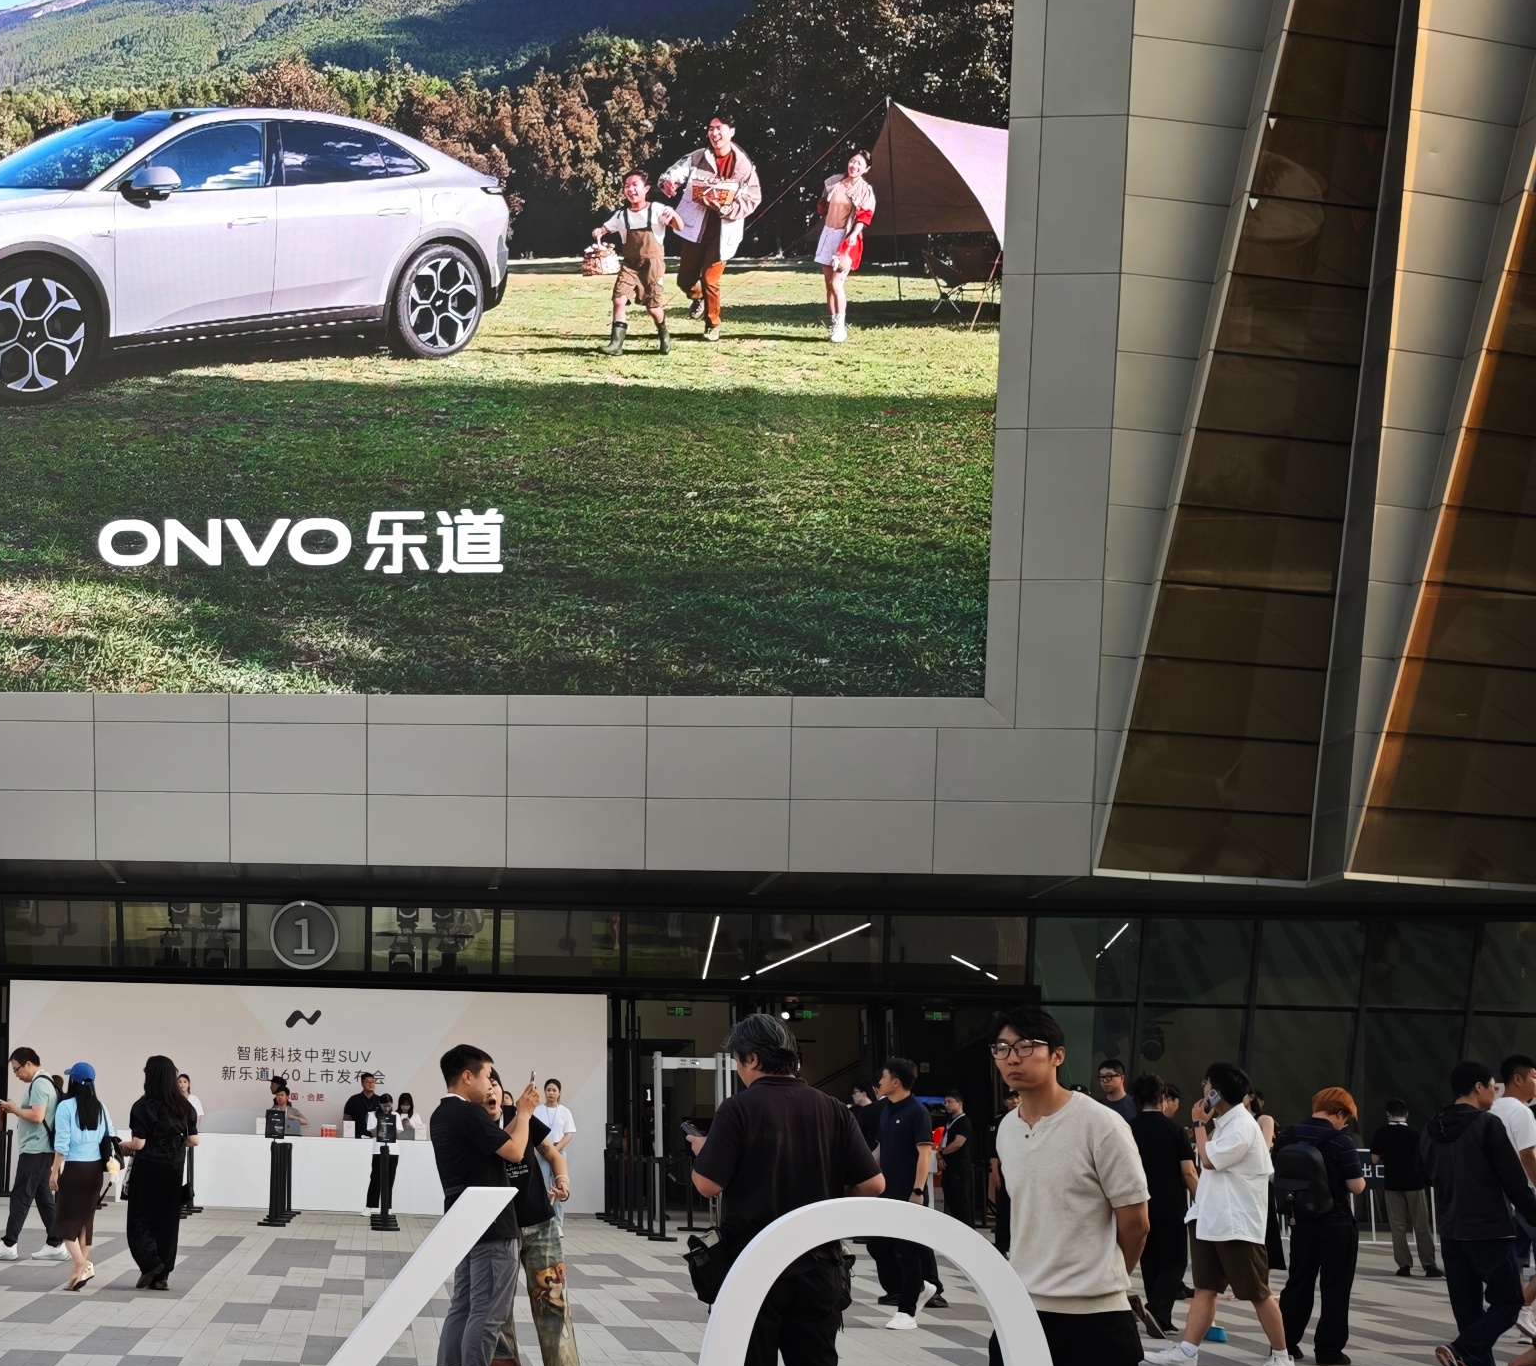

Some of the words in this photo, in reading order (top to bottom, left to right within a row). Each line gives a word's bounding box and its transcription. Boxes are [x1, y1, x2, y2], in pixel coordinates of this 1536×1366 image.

[98, 517, 352, 567] ONVO
[364, 508, 504, 574] 乐道
[293, 918, 316, 955] 1
[236, 1045, 372, 1064] 智能科技中型SUV
